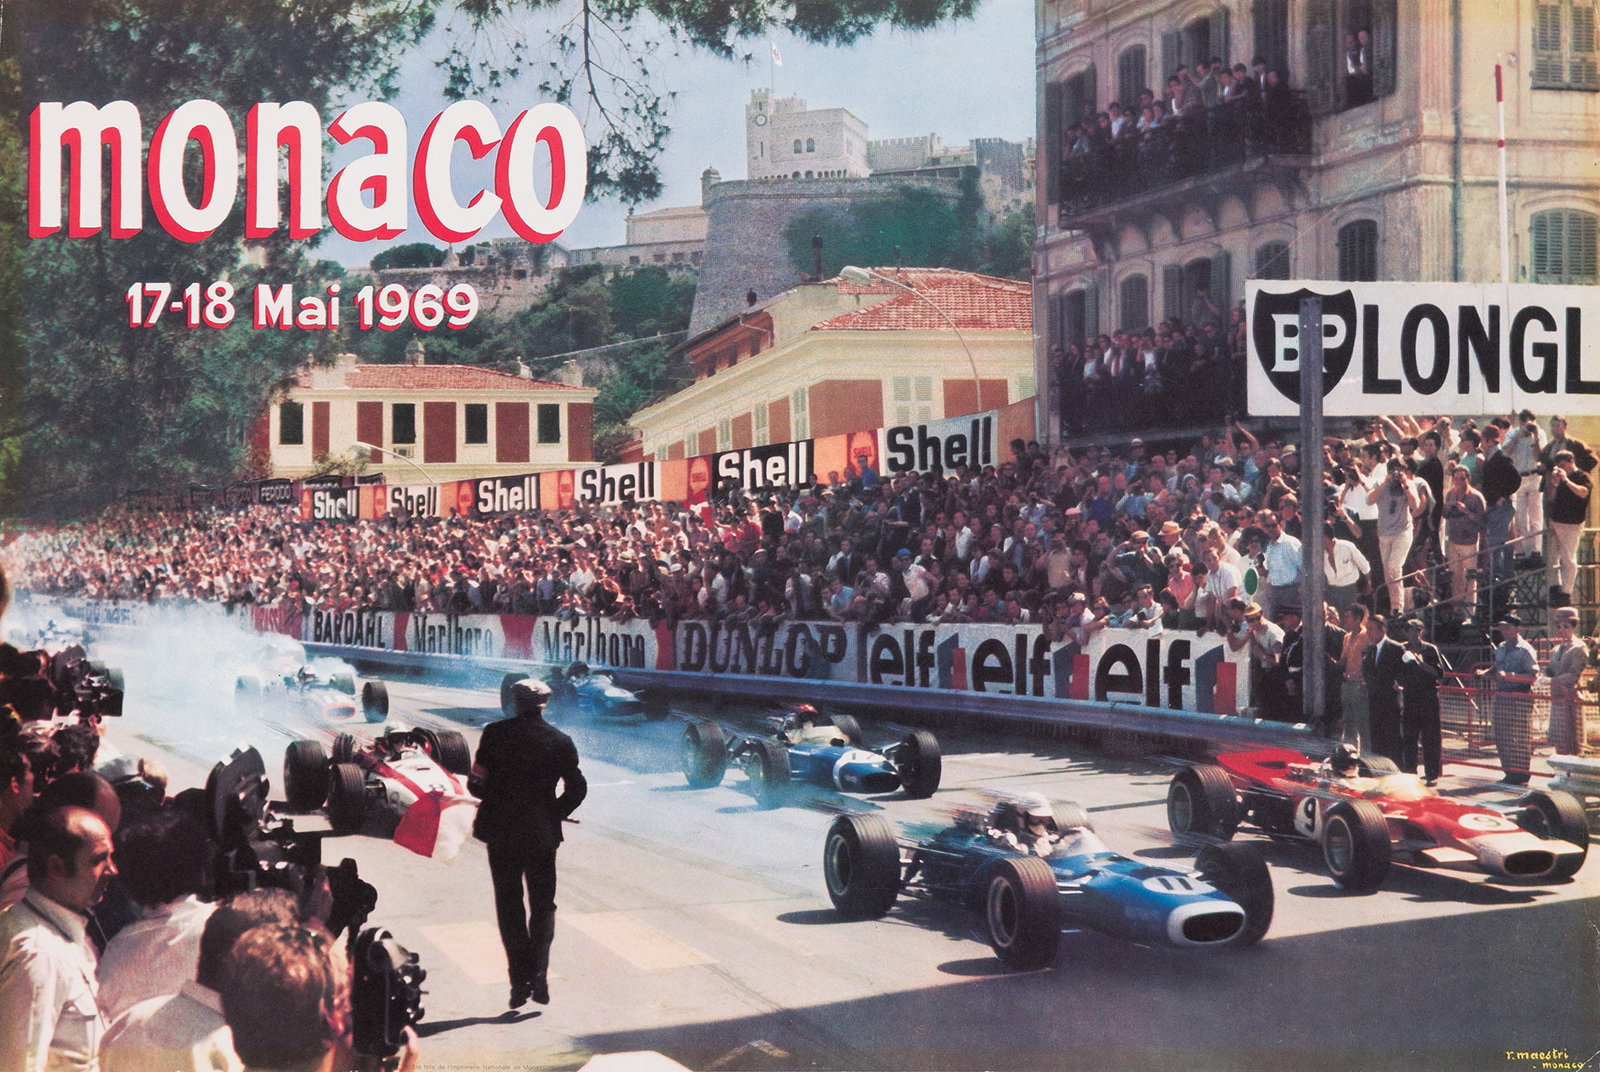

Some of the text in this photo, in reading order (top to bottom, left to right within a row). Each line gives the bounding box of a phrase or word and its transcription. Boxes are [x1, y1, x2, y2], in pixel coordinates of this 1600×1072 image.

[29, 99, 588, 243] monaco
[126, 281, 479, 330] 17-18 Mai 1969
[1271, 303, 1600, 395] BP LONGL
[718, 441, 807, 490] Shell
[886, 416, 992, 473] Shell
[314, 489, 358, 519] Shell
[391, 486, 437, 517] Shell
[478, 476, 538, 513] Shell
[581, 462, 655, 503] Shell
[314, 609, 386, 649] BARDAHL
[414, 614, 494, 653] Marlboro
[543, 615, 646, 669] Marlboro
[681, 621, 847, 678] DUNLOP
[870, 630, 936, 687] elf
[972, 630, 1051, 696] elf
[1096, 638, 1191, 710] elf
[1304, 796, 1317, 830] 9
[1157, 876, 1194, 891] 11
